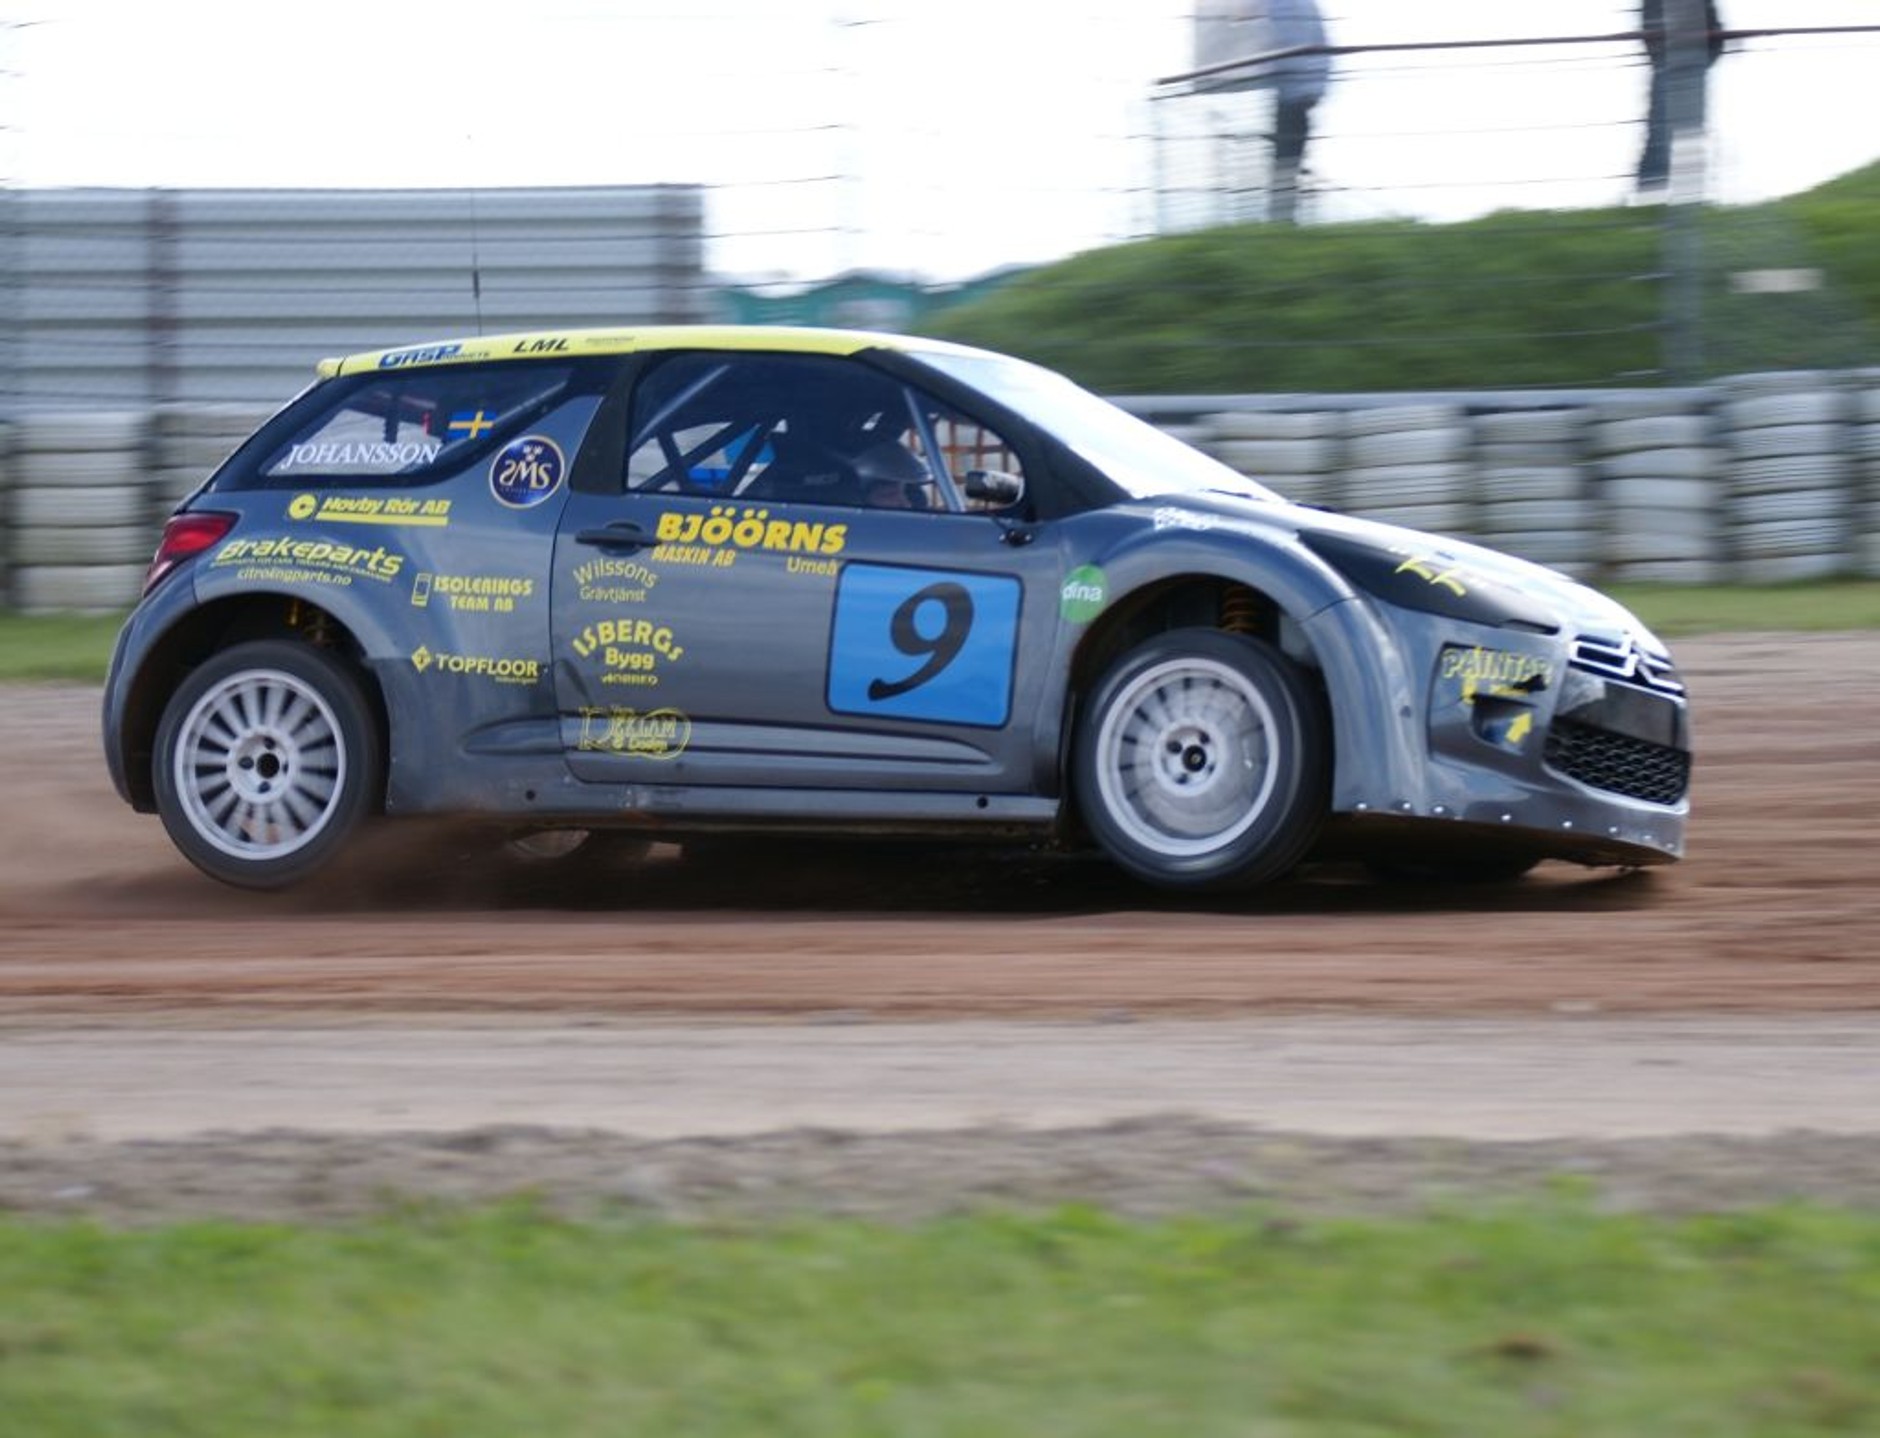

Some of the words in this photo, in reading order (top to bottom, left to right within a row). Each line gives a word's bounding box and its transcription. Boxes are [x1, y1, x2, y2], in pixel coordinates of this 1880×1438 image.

[512, 338, 569, 353] LML
[281, 443, 441, 469] JOHANSSON
[421, 500, 450, 514] AB
[656, 506, 847, 555] BJÖÖRNS
[216, 537, 404, 575] Brakeparts
[652, 545, 711, 566] MASKIN
[712, 549, 736, 567] AB
[572, 558, 658, 589] Wilssons
[451, 595, 490, 611] TEAM
[1061, 581, 1103, 602] dina
[867, 581, 975, 702] 9
[435, 654, 538, 676] TOPFLOOR
[605, 646, 655, 671] Bygg
